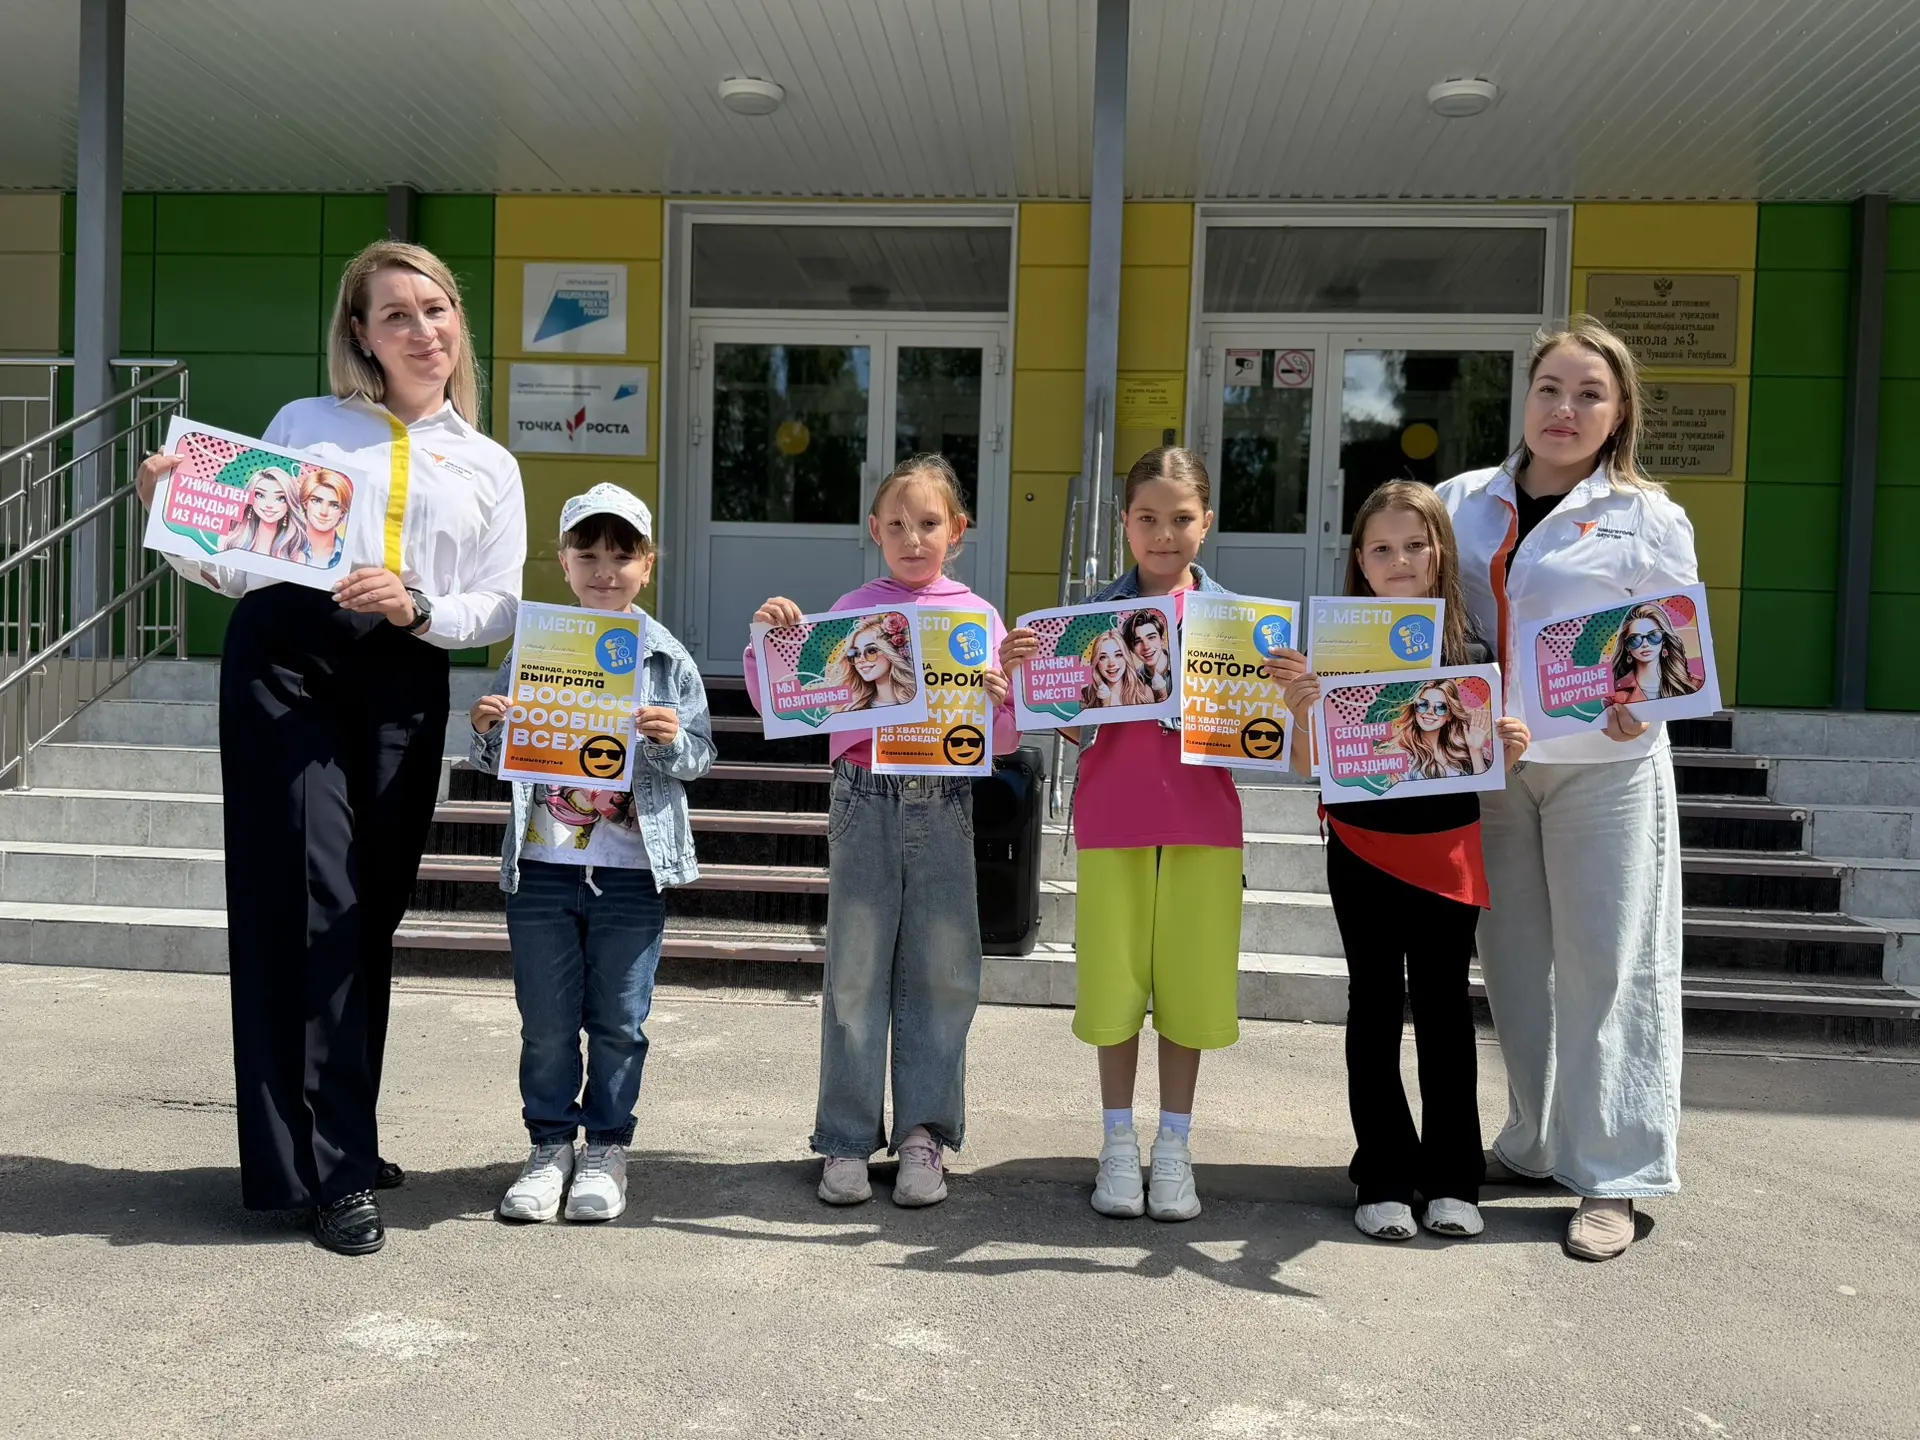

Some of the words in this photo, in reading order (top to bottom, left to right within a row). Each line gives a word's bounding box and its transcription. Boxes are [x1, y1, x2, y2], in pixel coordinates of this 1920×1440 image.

[1679, 312, 1720, 321] учреждение
[1687, 349, 1727, 360] Республики
[517, 420, 563, 432] ТОЧКА
[586, 422, 630, 434] РОСТА
[179, 474, 250, 504] УНИКАЛЕН
[174, 491, 240, 518] КАЖДЫЙ
[171, 507, 190, 522] ИЗ
[192, 512, 224, 531] НАС!
[1204, 604, 1257, 622] МЕСТО
[1316, 608, 1327, 624] 2
[1333, 609, 1393, 625] МЕСТО
[526, 613, 533, 628] 1
[538, 615, 596, 636] МЕСТО
[1187, 649, 1235, 661] КОМАНДА
[521, 663, 565, 674] команда,
[566, 668, 604, 678] которая
[1187, 659, 1270, 680] КОТОРО
[1547, 660, 1568, 676] МЫ
[520, 671, 605, 689] выиграла
[924, 669, 984, 687] ОРОЙ
[1031, 671, 1085, 687] БУДУЩЕЕ
[1548, 667, 1608, 691] МОЛОДЫЕ
[775, 681, 796, 695] МЫ
[1032, 686, 1076, 701] ВМЕСТЕ!
[1550, 693, 1559, 706] И
[1560, 682, 1609, 703] КРУТЫЕ!
[778, 688, 849, 709] ПОЗИТИВНЫЕ!
[927, 708, 985, 725] ЧУТЬ
[1185, 714, 1196, 722] НЕ
[1197, 715, 1241, 727] ХВАТИЛО
[896, 726, 942, 735] ХВАТИЛО
[1184, 723, 1197, 732] ДО
[1198, 723, 1238, 735] ПОБЕДЫ
[1334, 723, 1387, 740] СЕГОДНЯ
[512, 728, 588, 751] ВСЕХ
[880, 734, 895, 743] ДО
[897, 734, 940, 744] ПОБЕДЫ
[1335, 742, 1369, 758] НАШ
[1337, 757, 1403, 774] ПРАЗДНИК!
